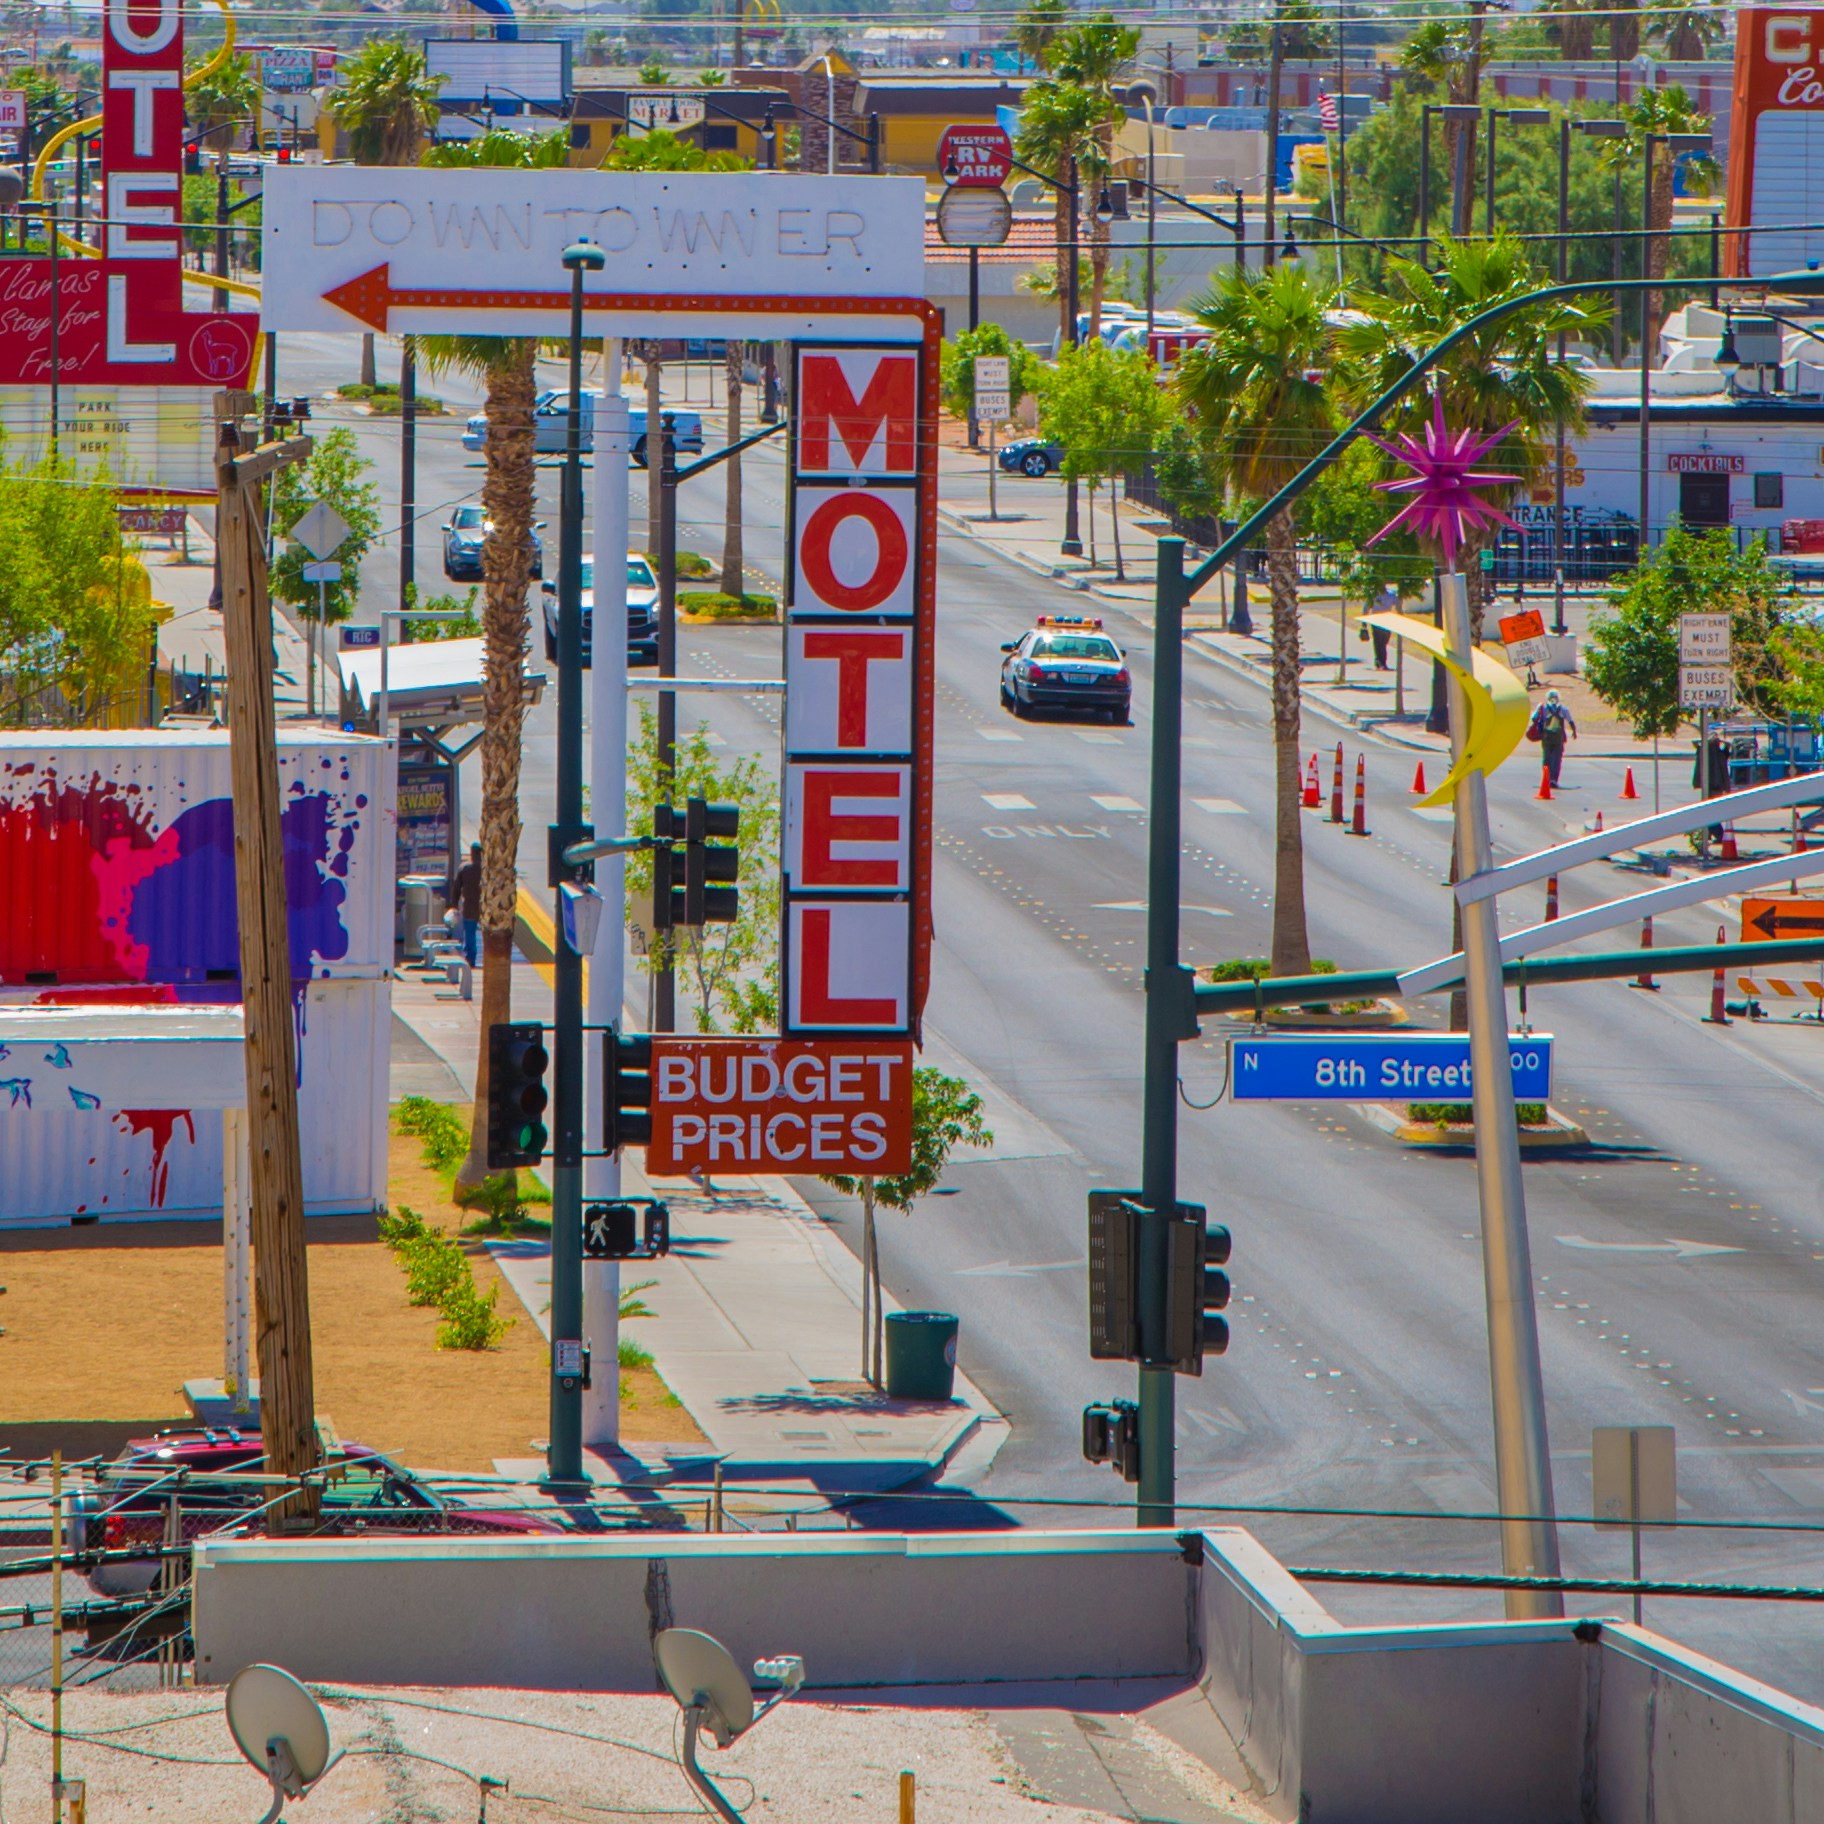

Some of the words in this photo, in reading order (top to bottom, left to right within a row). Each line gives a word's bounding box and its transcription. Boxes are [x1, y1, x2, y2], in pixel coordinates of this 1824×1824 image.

[265, 57, 309, 67] PIZZA
[633, 107, 702, 119] MRET
[948, 135, 1005, 145] WESTERN
[958, 145, 993, 164] RV
[944, 164, 1004, 177] ARK
[312, 199, 866, 258] DOWNTOWNER
[56, 300, 101, 335] for
[18, 342, 100, 377] Free!
[78, 401, 111, 412] PARK
[65, 422, 94, 433] YOUR
[1669, 455, 1744, 472] COCKTAILS
[116, 514, 183, 529] CANCY
[1692, 632, 1720, 643] MUST
[1686, 671, 1726, 685] BUSES
[800, 356, 917, 1025] MOTEL
[1683, 689, 1729, 702] EXEMPT
[980, 825, 1112, 839] ONLY
[1244, 1052, 1259, 1071] N
[1509, 1052, 1540, 1070] 00
[658, 1054, 904, 1103] BUDGET
[1315, 1058, 1366, 1087] 8th
[1380, 1058, 1472, 1087] Street
[672, 1112, 887, 1161] PRICES
